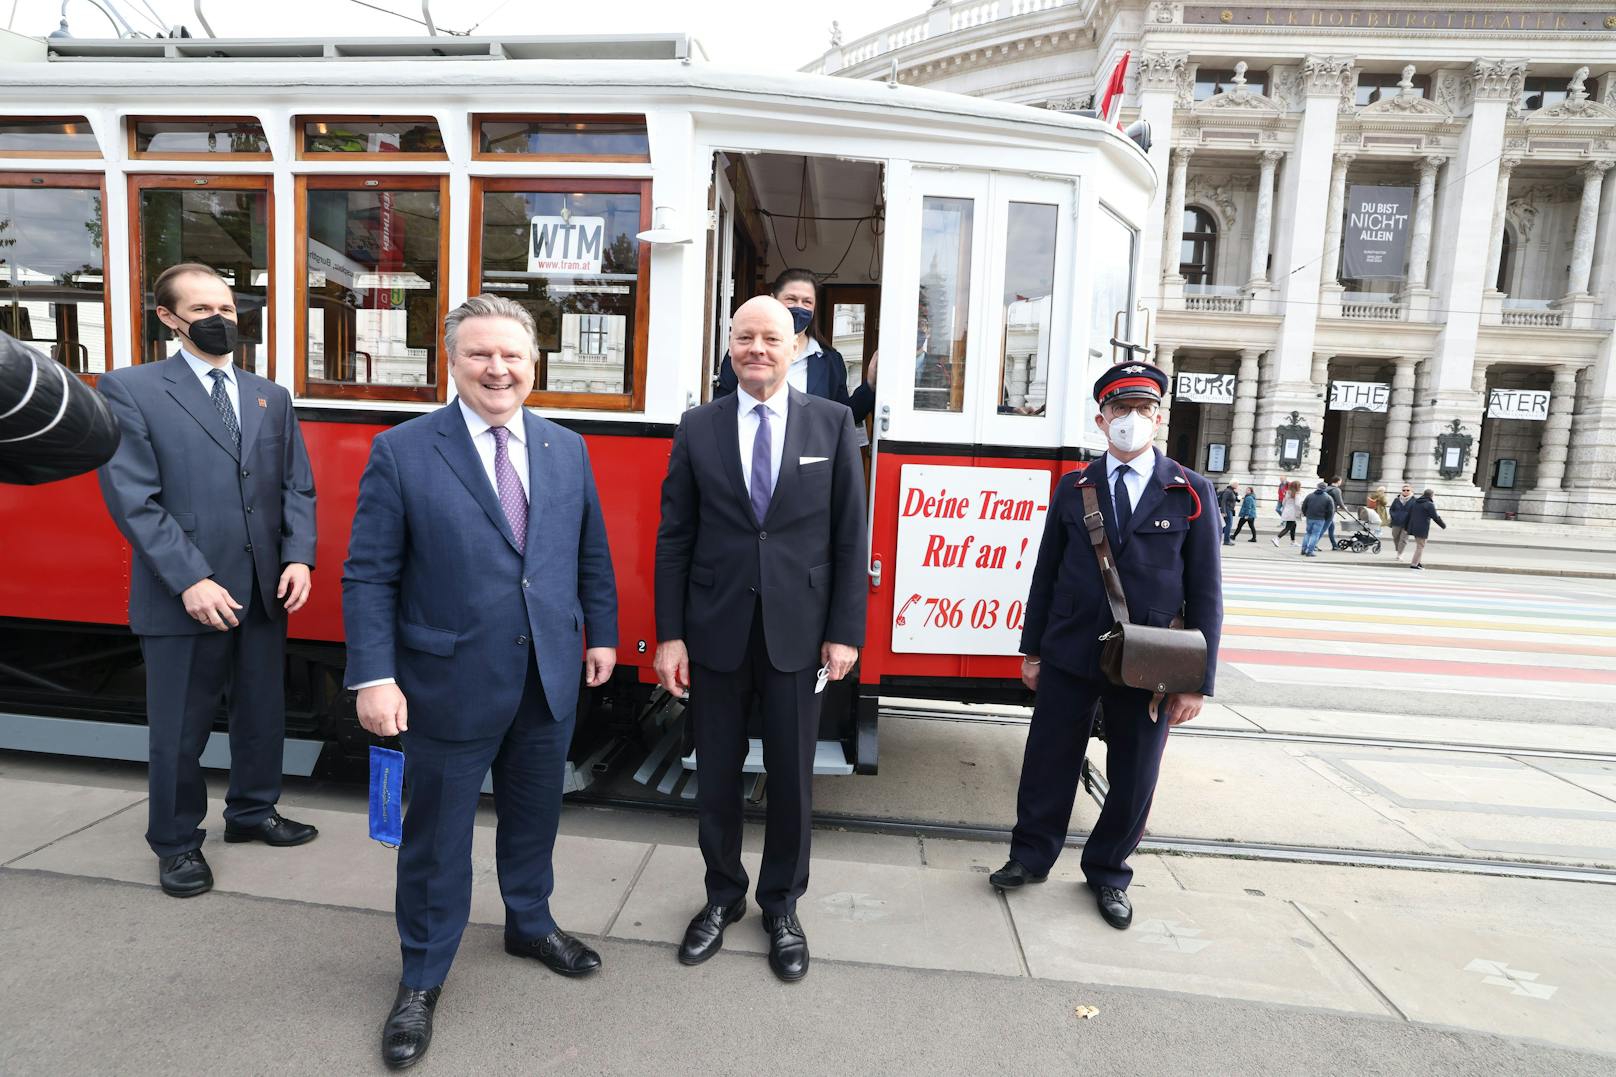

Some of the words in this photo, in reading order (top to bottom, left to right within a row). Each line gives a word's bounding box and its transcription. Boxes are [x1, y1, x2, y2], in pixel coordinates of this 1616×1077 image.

[1361, 203, 1376, 213] DU
[1377, 203, 1399, 214] BIST
[1350, 213, 1408, 230] NICHT
[532, 223, 602, 260] WTM
[1360, 230, 1394, 241] ALLEIN
[538, 260, 590, 271] www.tram.at
[902, 487, 969, 519] Deine
[978, 490, 1047, 521] Tram-
[922, 534, 975, 569] Ruf
[975, 544, 1007, 569] an
[923, 597, 966, 628] 786
[970, 599, 1000, 630] 03
[638, 640, 646, 652] 2
